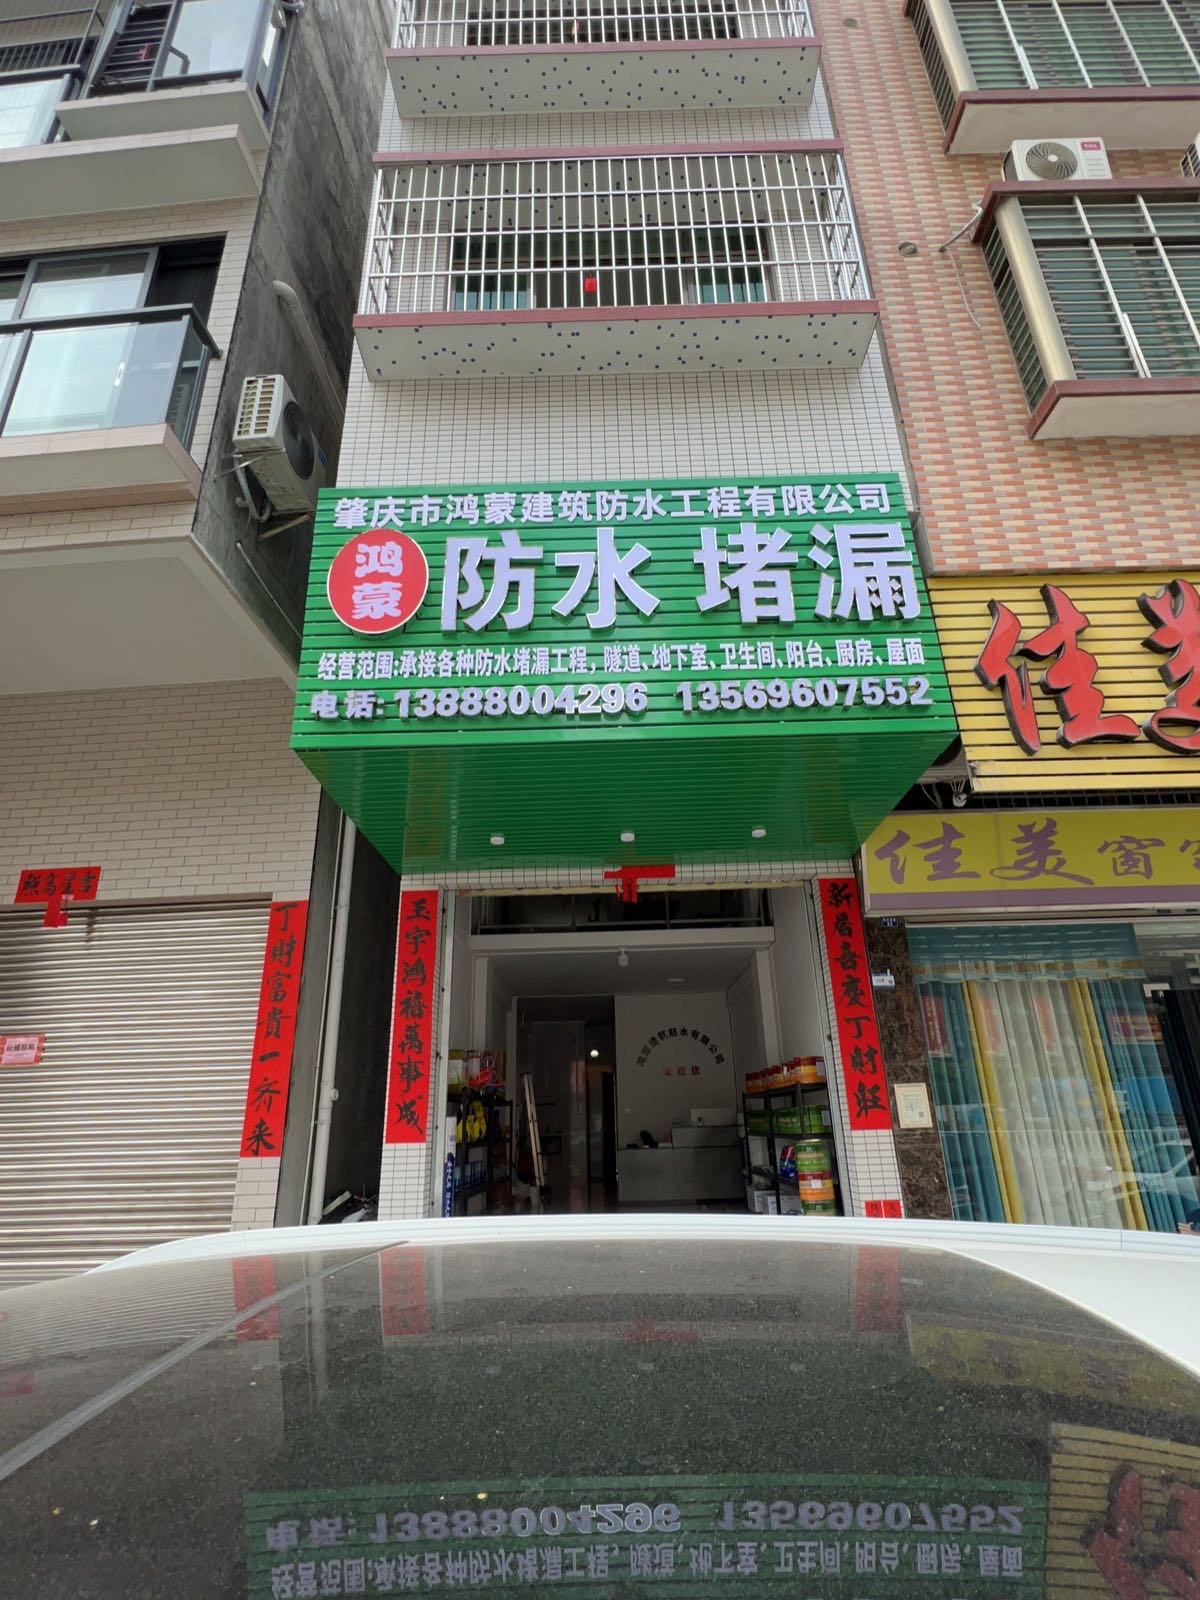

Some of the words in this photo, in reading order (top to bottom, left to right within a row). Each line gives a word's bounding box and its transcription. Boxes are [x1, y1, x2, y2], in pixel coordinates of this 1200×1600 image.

[334, 484, 891, 528] 肇庆市鸿蒙建筑防水工程有限公司
[354, 541, 403, 621] 鸿蒙
[442, 527, 661, 632] 防水
[693, 520, 921, 624] 堵漏
[676, 676, 933, 713] 13569607552
[874, 817, 1200, 885] 佳美窗
